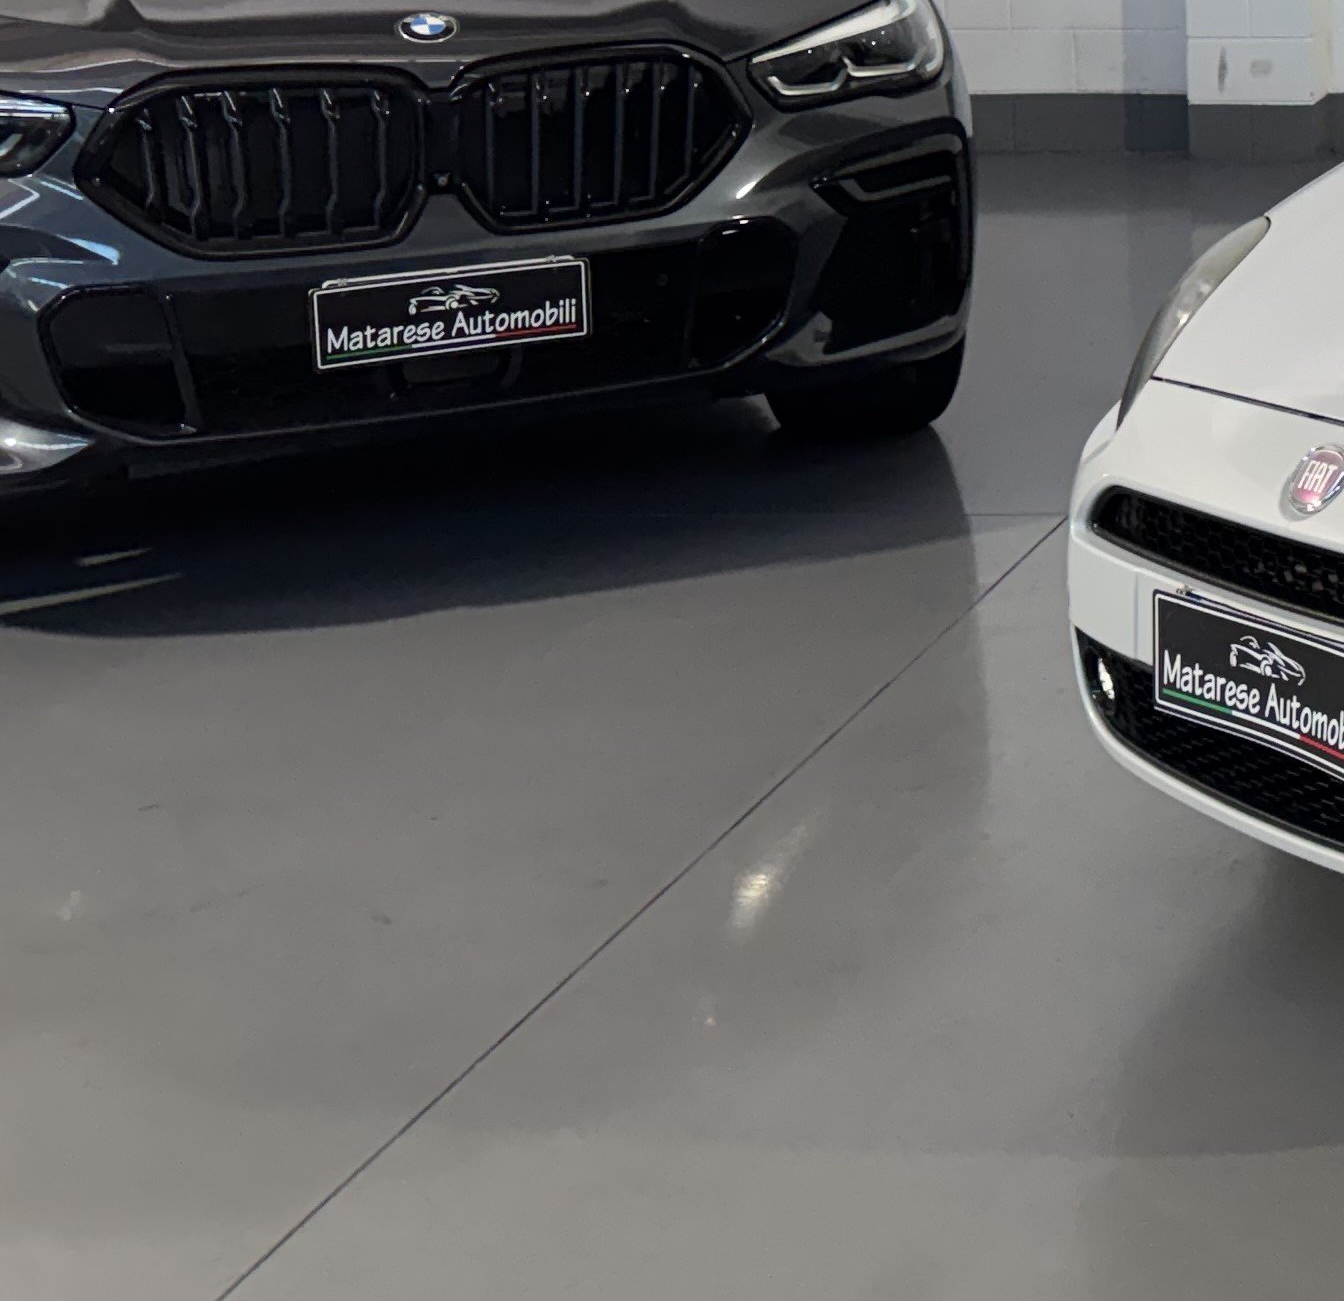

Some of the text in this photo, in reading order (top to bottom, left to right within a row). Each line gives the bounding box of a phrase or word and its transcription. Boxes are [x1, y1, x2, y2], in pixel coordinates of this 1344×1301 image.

[327, 299, 576, 353] Matarese Automobili
[1297, 460, 1339, 494] FIAT
[1164, 650, 1260, 714] Matarese
